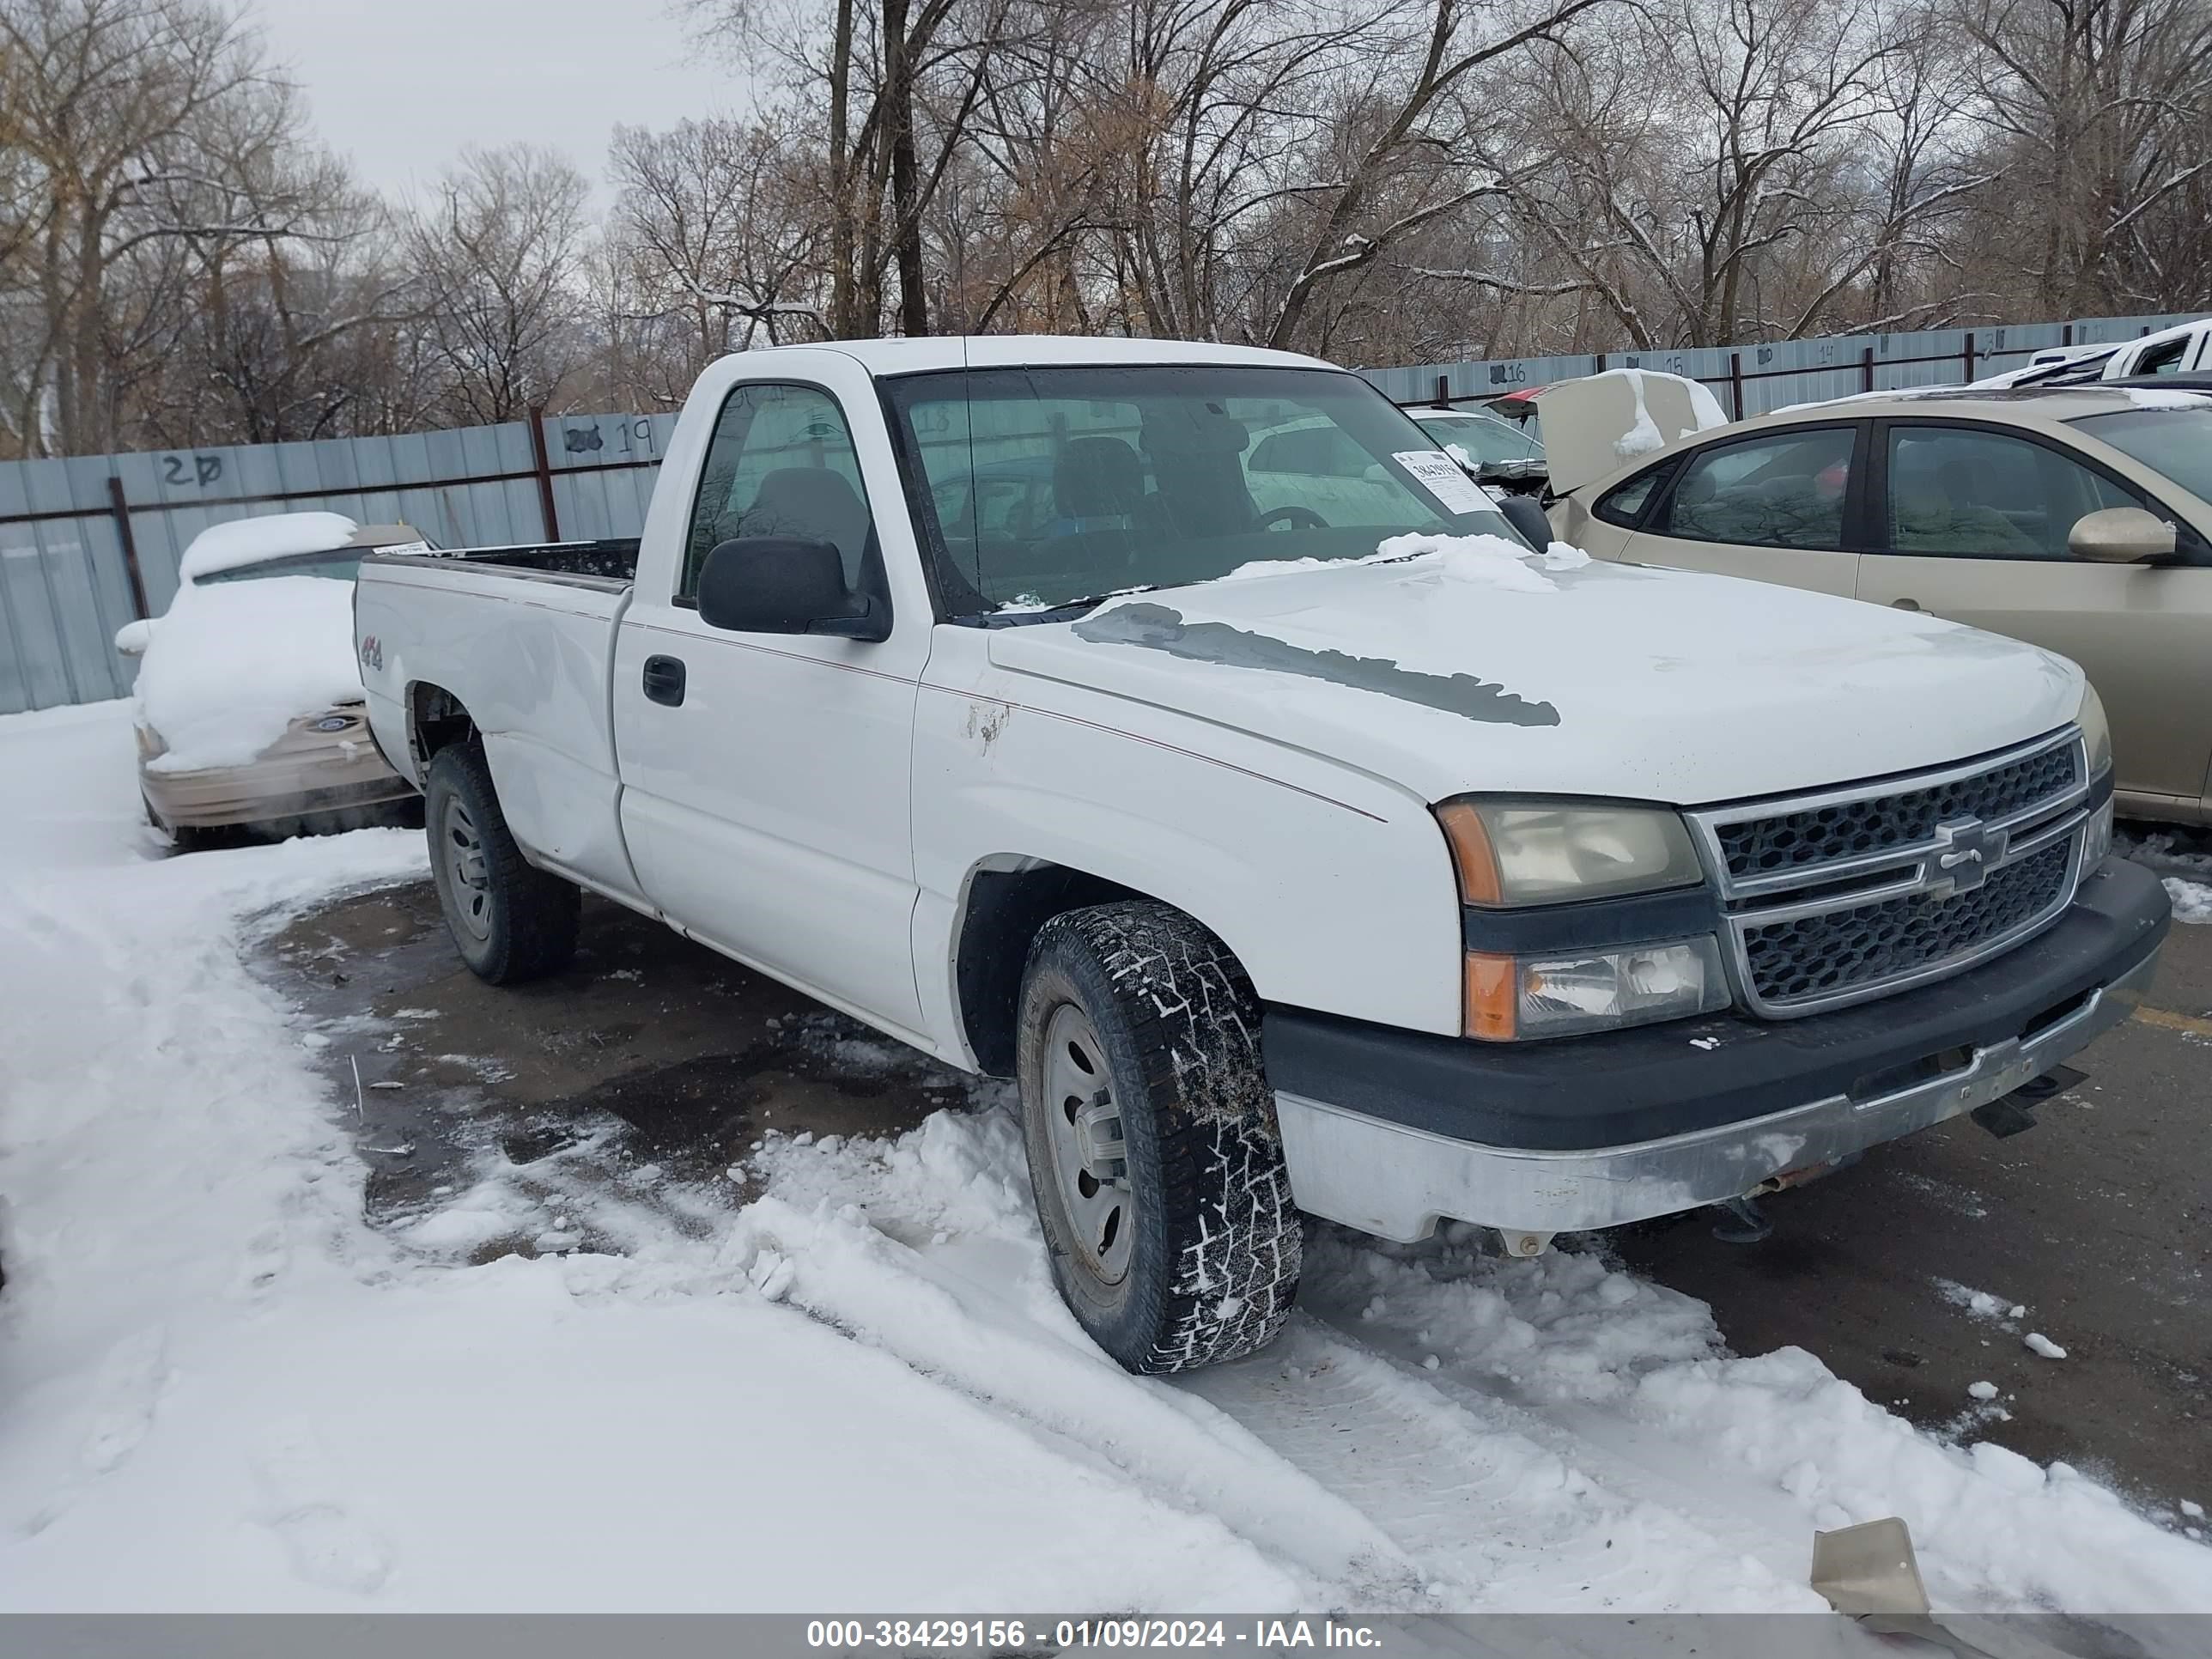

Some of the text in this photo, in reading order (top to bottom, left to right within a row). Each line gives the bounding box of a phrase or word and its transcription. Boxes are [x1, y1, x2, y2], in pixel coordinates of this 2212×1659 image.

[1819, 345, 1833, 364] 14
[1508, 363, 1526, 383] 16
[1666, 356, 1683, 376] 15
[616, 418, 653, 453] 19
